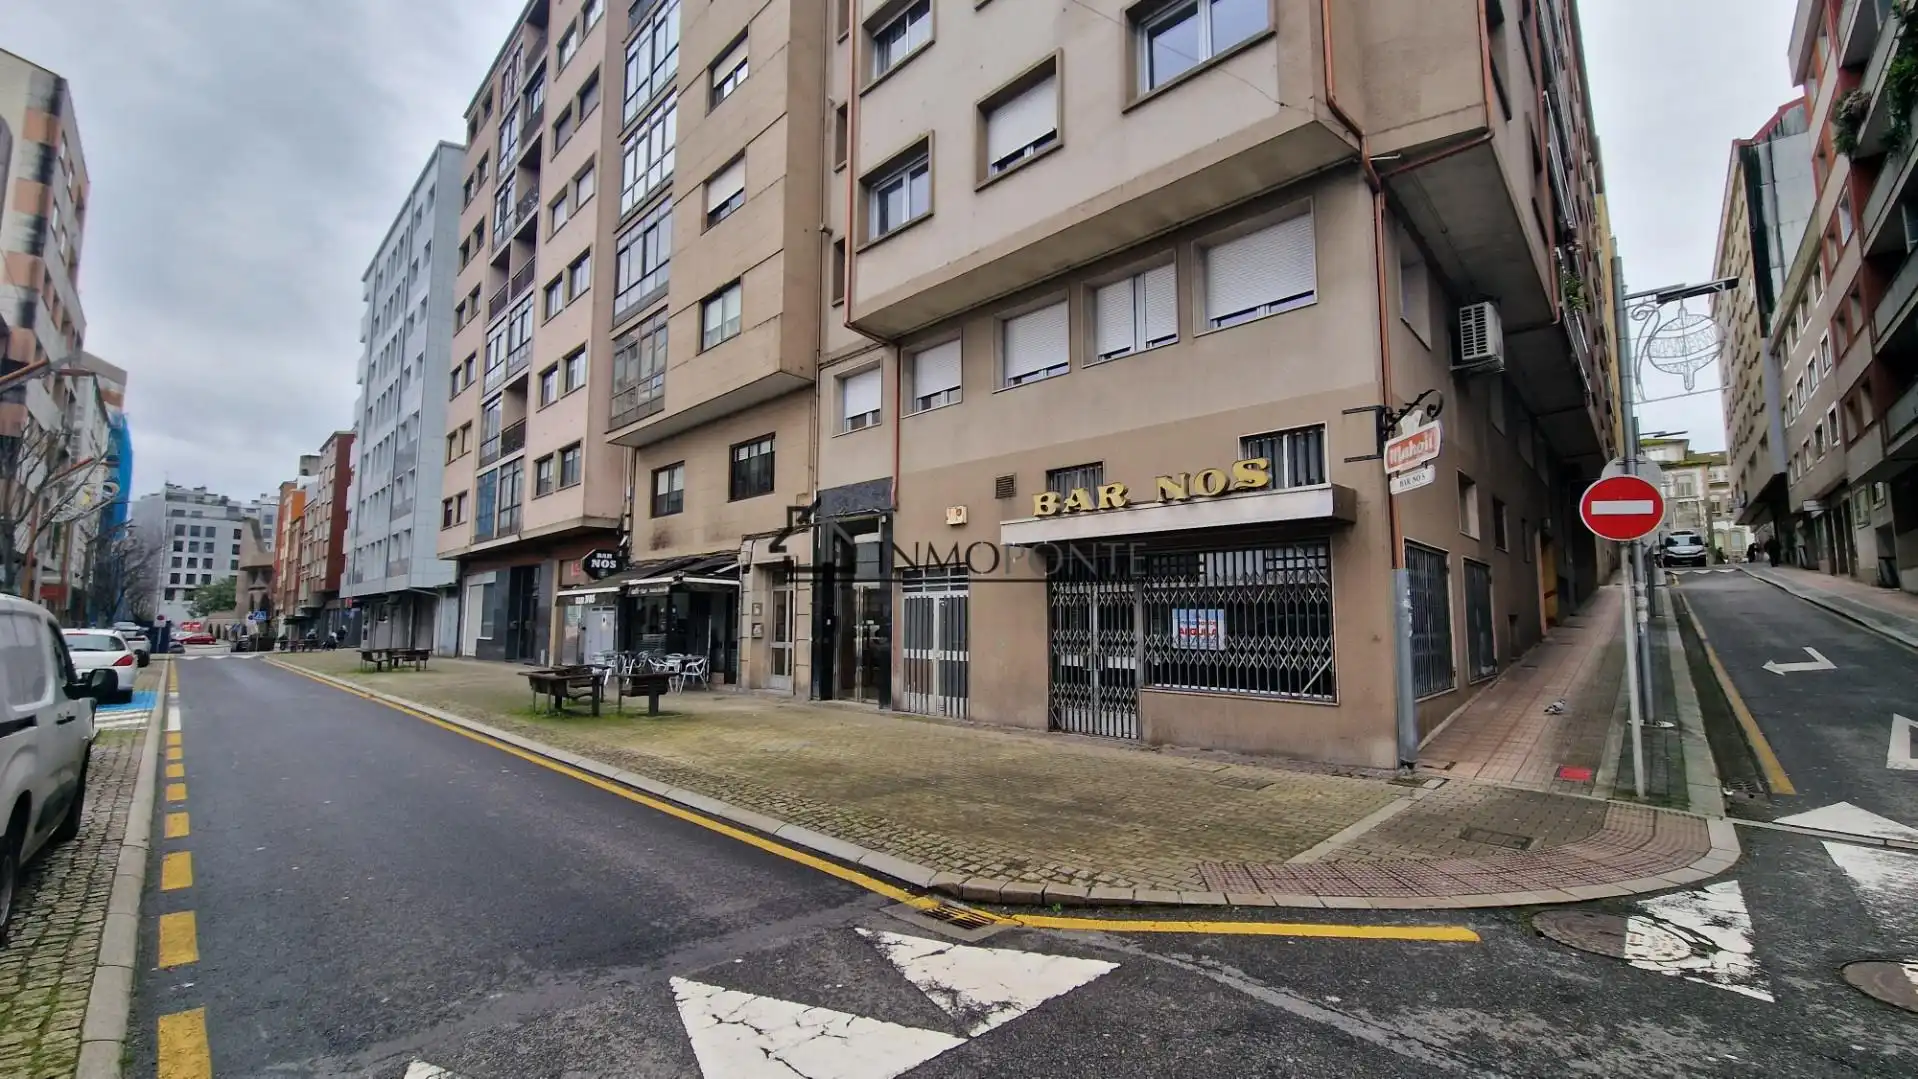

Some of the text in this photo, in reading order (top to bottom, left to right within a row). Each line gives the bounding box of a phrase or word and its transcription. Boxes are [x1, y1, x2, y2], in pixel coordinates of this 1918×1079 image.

[1032, 457, 1272, 517] BAR NOS
[591, 559, 617, 568] NOS
